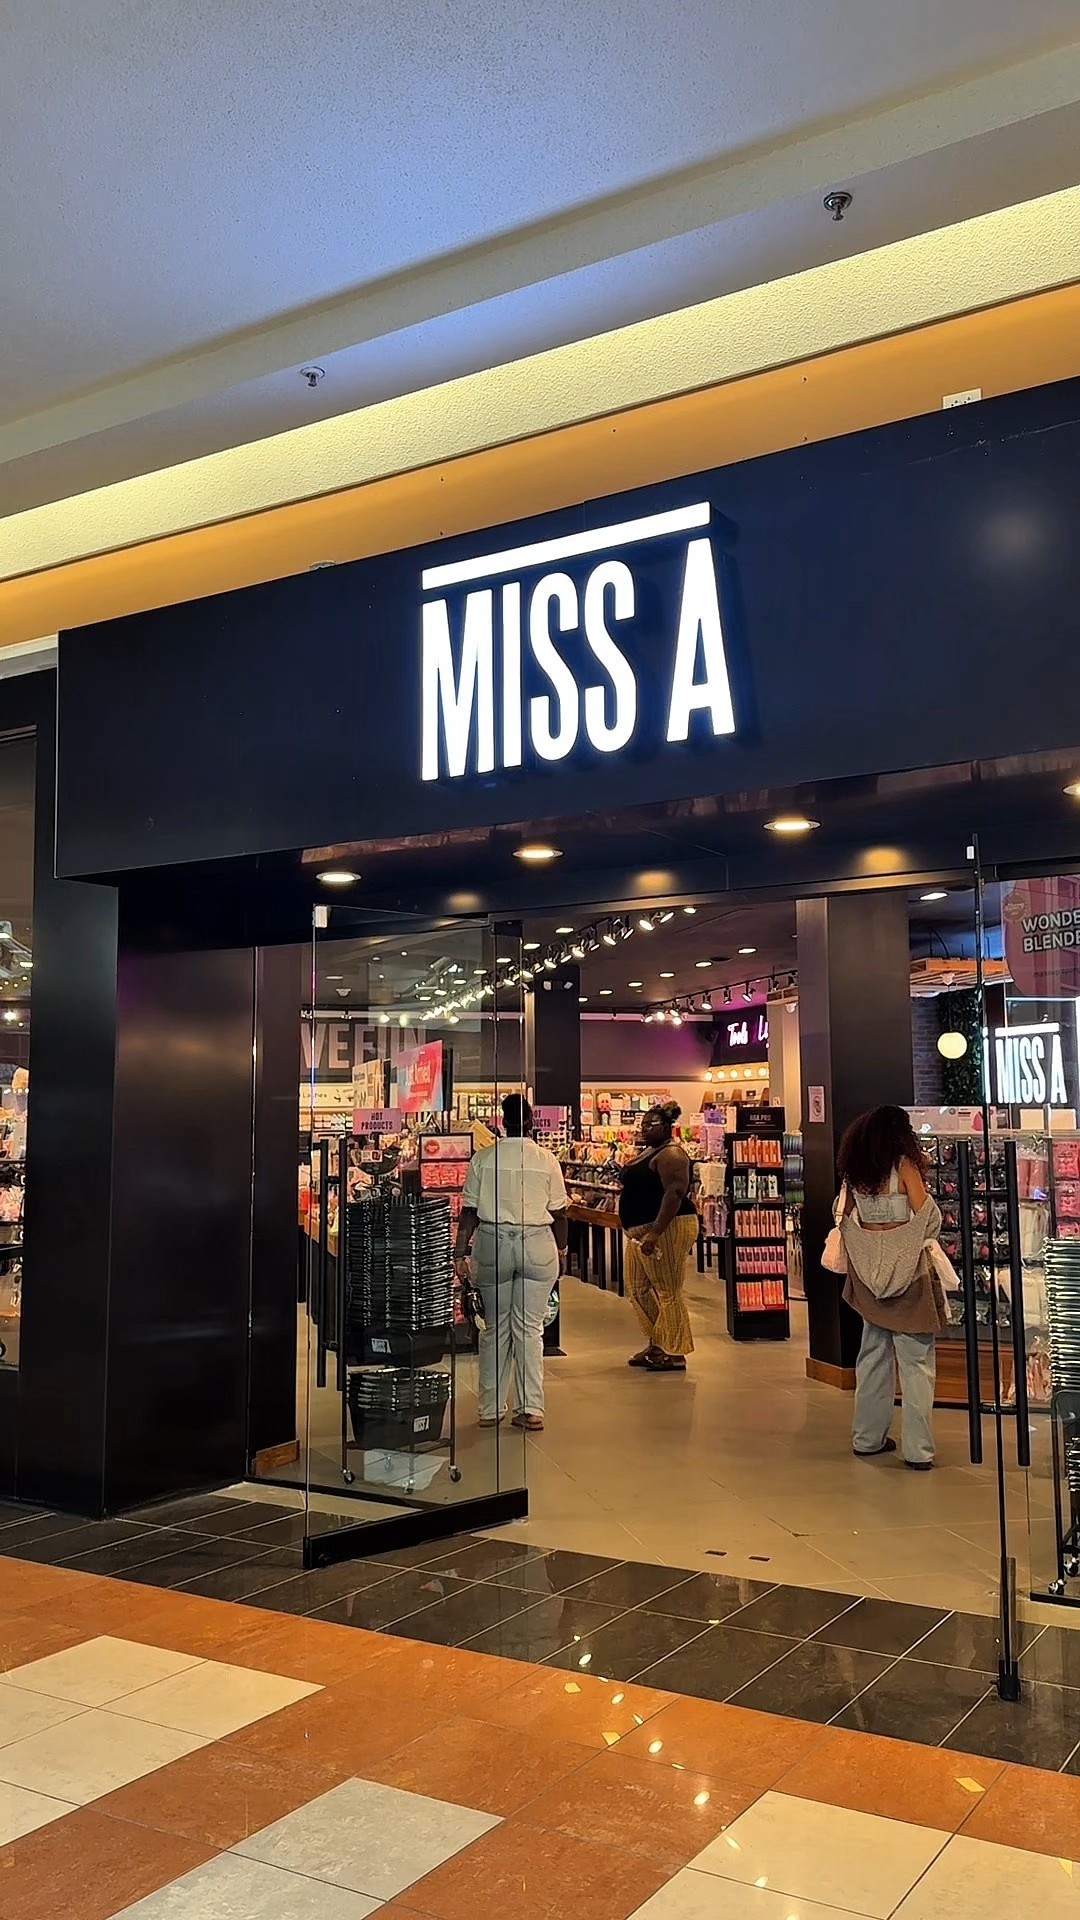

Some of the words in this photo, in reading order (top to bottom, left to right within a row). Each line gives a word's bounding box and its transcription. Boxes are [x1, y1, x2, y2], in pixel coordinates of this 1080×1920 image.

[421, 560, 637, 781] MISS
[666, 537, 736, 743] A
[995, 1036, 1046, 1104] MISS
[1050, 1034, 1068, 1104] A
[360, 1121, 394, 1130] PRODUCTS
[370, 1112, 384, 1121] HOT
